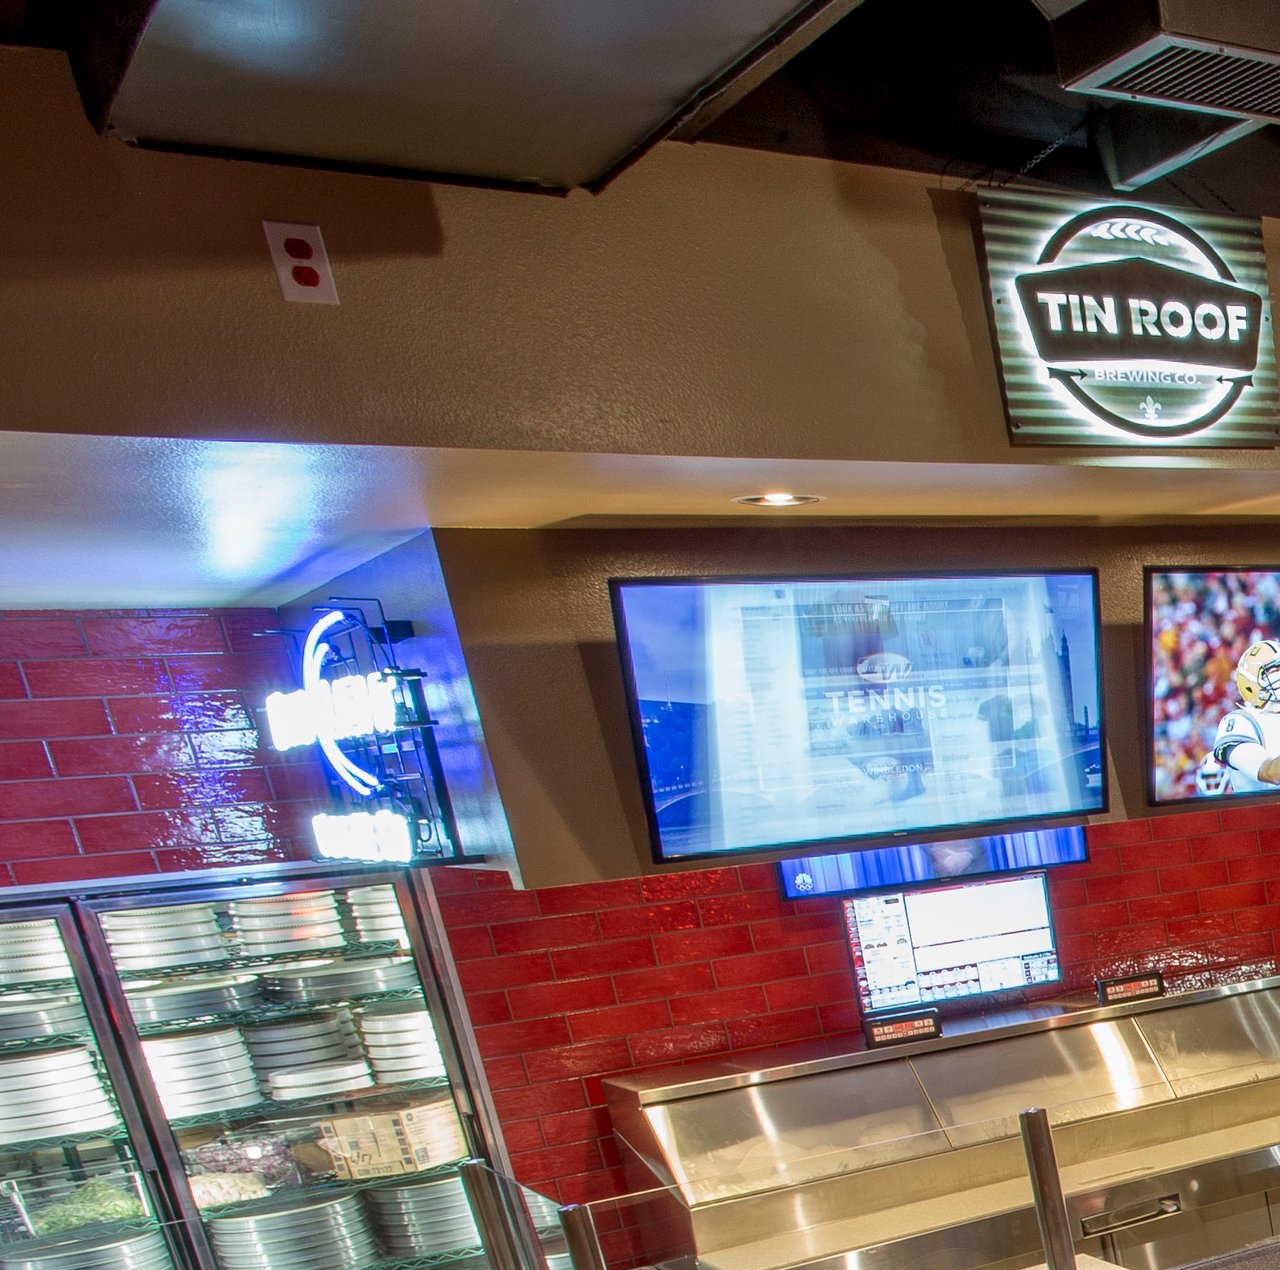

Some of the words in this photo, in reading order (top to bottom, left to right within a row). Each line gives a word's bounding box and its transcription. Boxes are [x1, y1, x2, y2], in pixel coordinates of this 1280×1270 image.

[1036, 291, 1119, 334] TIN
[1128, 297, 1248, 341] ROOF
[1094, 368, 1172, 384] BREWING
[1175, 372, 1201, 385] CO.
[824, 684, 947, 713] TENNIS
[831, 709, 949, 727] WAREHOUSE
